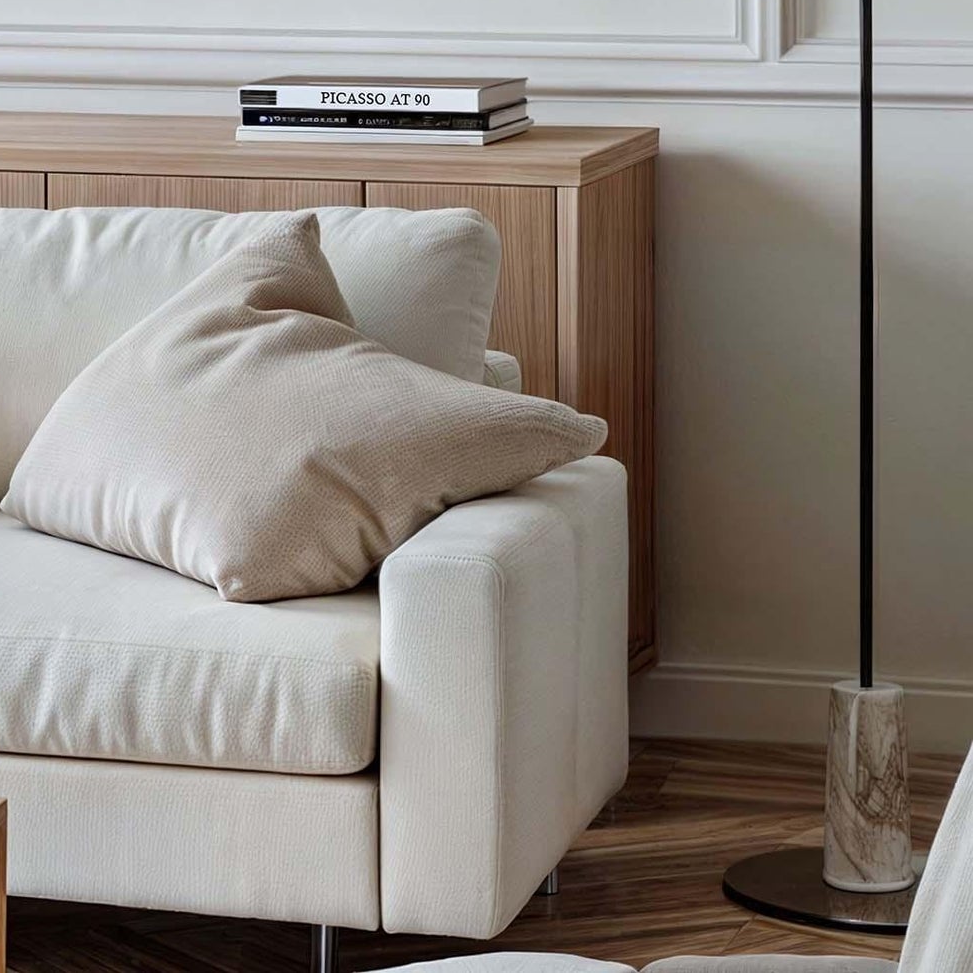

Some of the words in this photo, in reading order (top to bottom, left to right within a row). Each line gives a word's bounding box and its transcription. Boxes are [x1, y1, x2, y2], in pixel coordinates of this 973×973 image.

[321, 91, 385, 106] PICASSO
[391, 93, 410, 106] AT
[414, 93, 430, 107] 90
